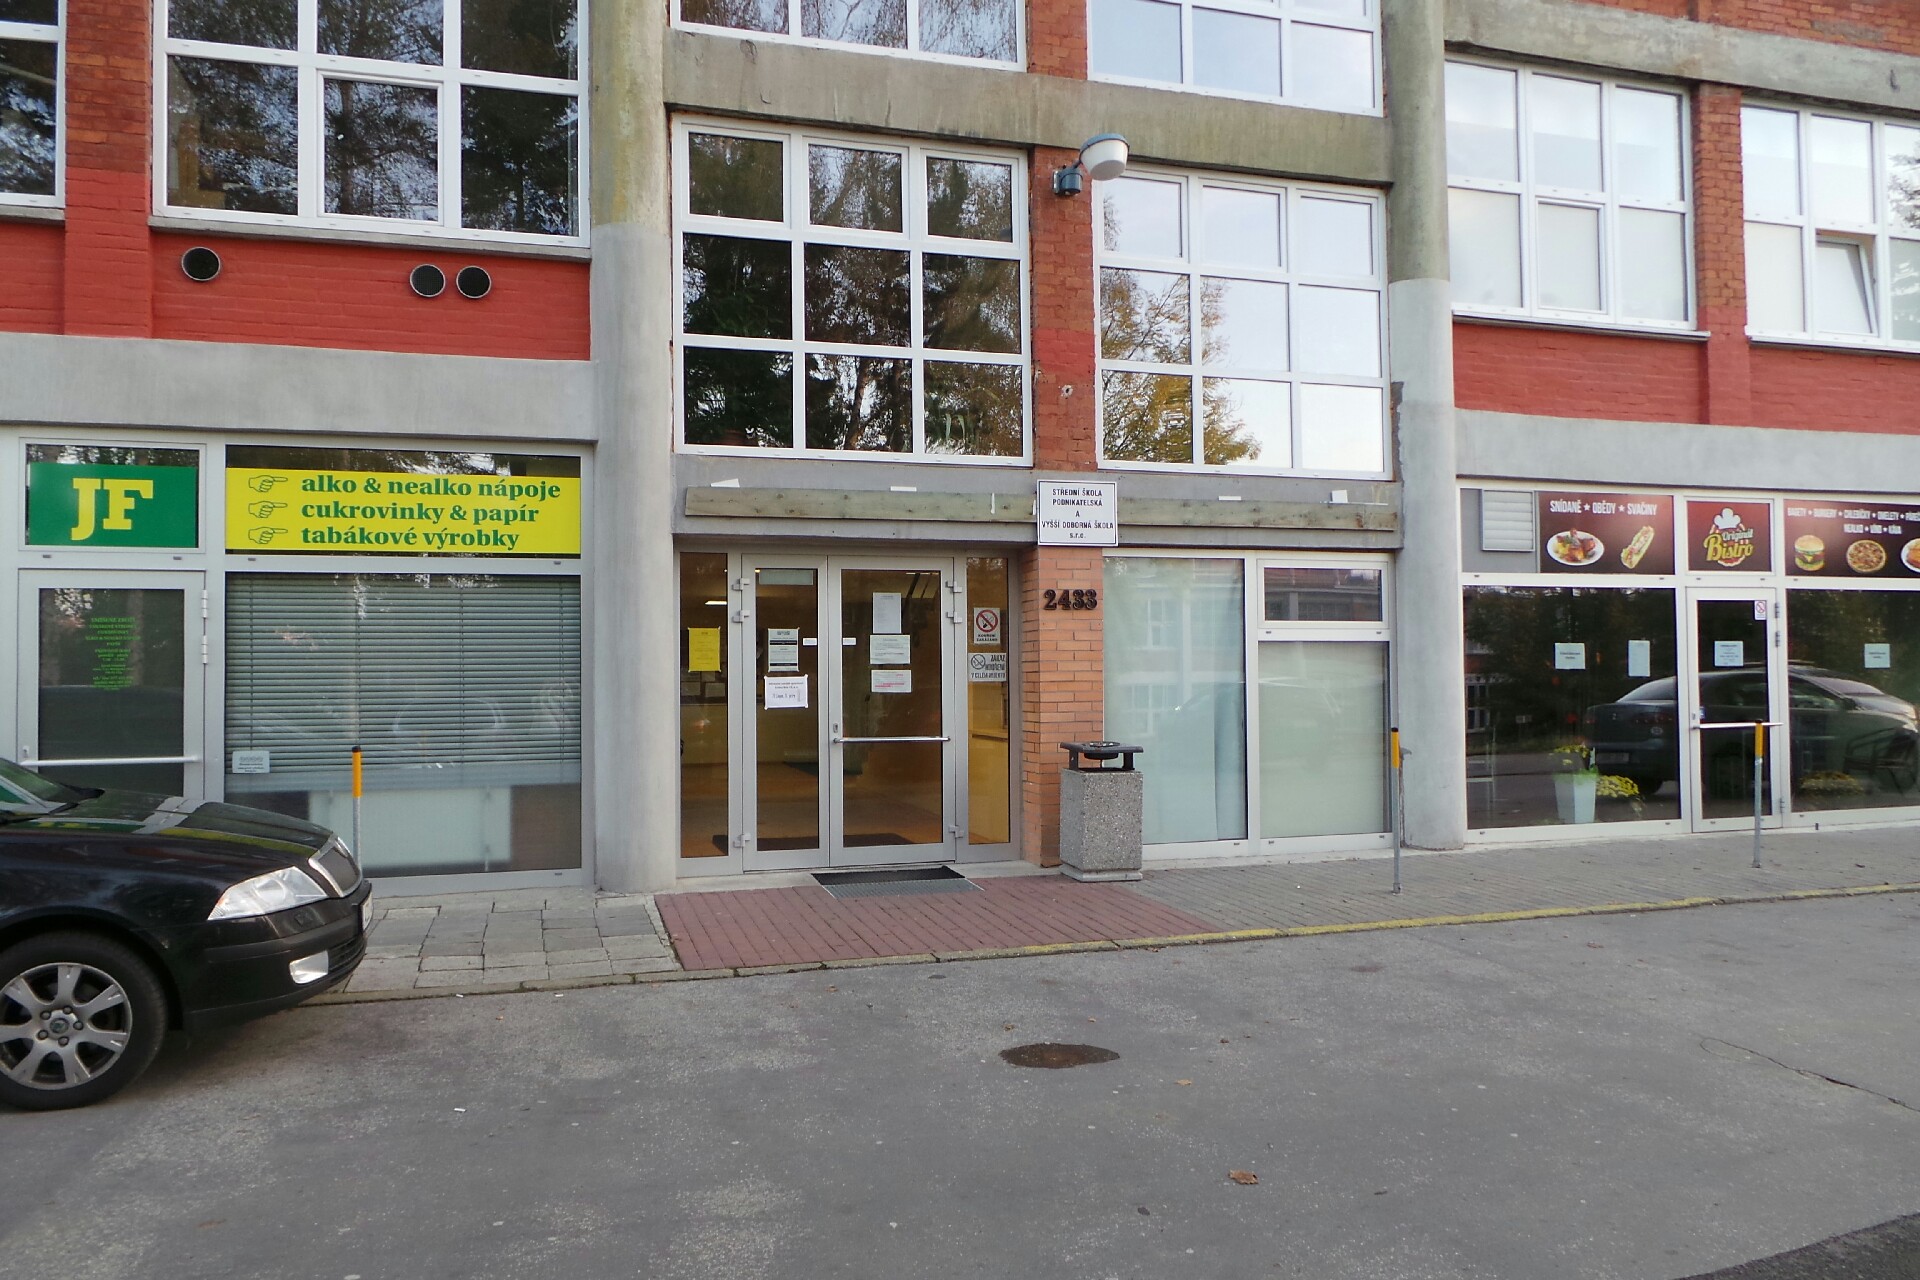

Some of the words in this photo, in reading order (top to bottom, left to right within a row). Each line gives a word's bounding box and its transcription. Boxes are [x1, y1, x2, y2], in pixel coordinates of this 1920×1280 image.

[301, 475, 357, 494] alko
[363, 478, 381, 494] &
[388, 478, 472, 496] nealko
[477, 479, 561, 502] nápoje
[1052, 487, 1080, 496] STŘEDNÍ
[1082, 488, 1102, 497] ŠKOLA
[71, 477, 154, 541] JF
[301, 501, 444, 524] cukrovinky
[449, 505, 467, 521] &
[473, 504, 540, 526] papír
[1052, 498, 1103, 506] PODNIKATELSKÁ
[1549, 498, 1582, 514] SNÍDANĚ
[1592, 500, 1616, 514] OBĚDY
[1627, 501, 1658, 516] SVAČINY
[1042, 519, 1060, 528] VYŠŠÍ
[1062, 519, 1092, 529] ODBORNÁ
[1094, 520, 1114, 529] ŠKOLA
[301, 525, 417, 546] tabákové
[422, 527, 520, 550] výrobky
[1703, 533, 1754, 561] Bistro
[1043, 589, 1098, 610] 2433
